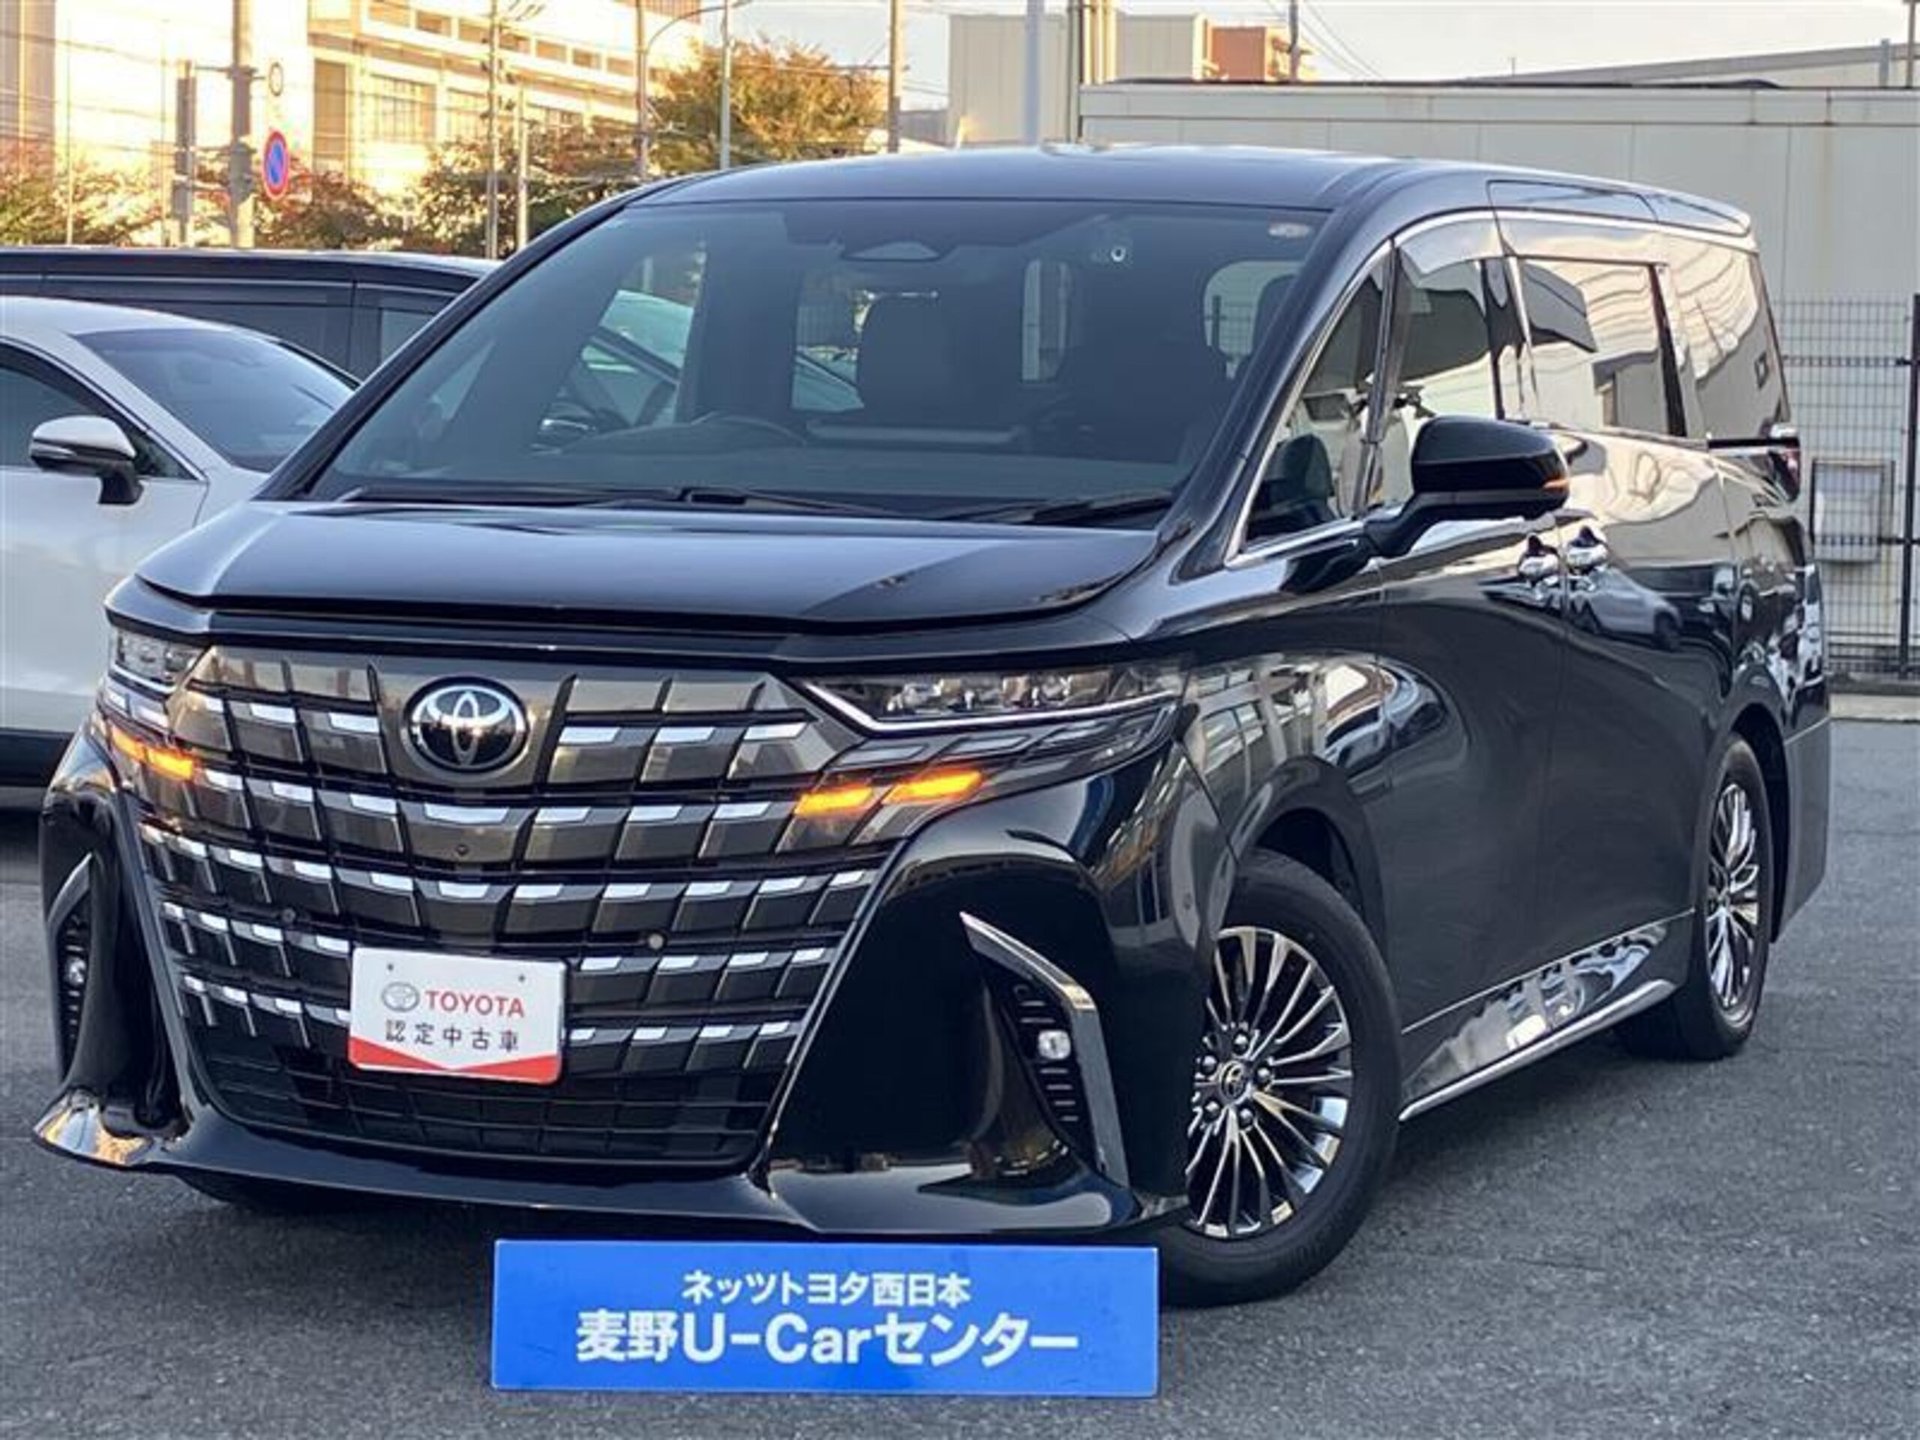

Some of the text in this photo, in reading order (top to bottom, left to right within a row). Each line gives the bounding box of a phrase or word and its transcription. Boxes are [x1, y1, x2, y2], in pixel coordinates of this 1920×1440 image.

[425, 990, 525, 1018] TOYOTA
[385, 1019, 519, 1052] 認定中古車
[682, 1270, 971, 1308] ネッツトヨタ西日本
[576, 1308, 1079, 1367] 麦野U-Carセンター
